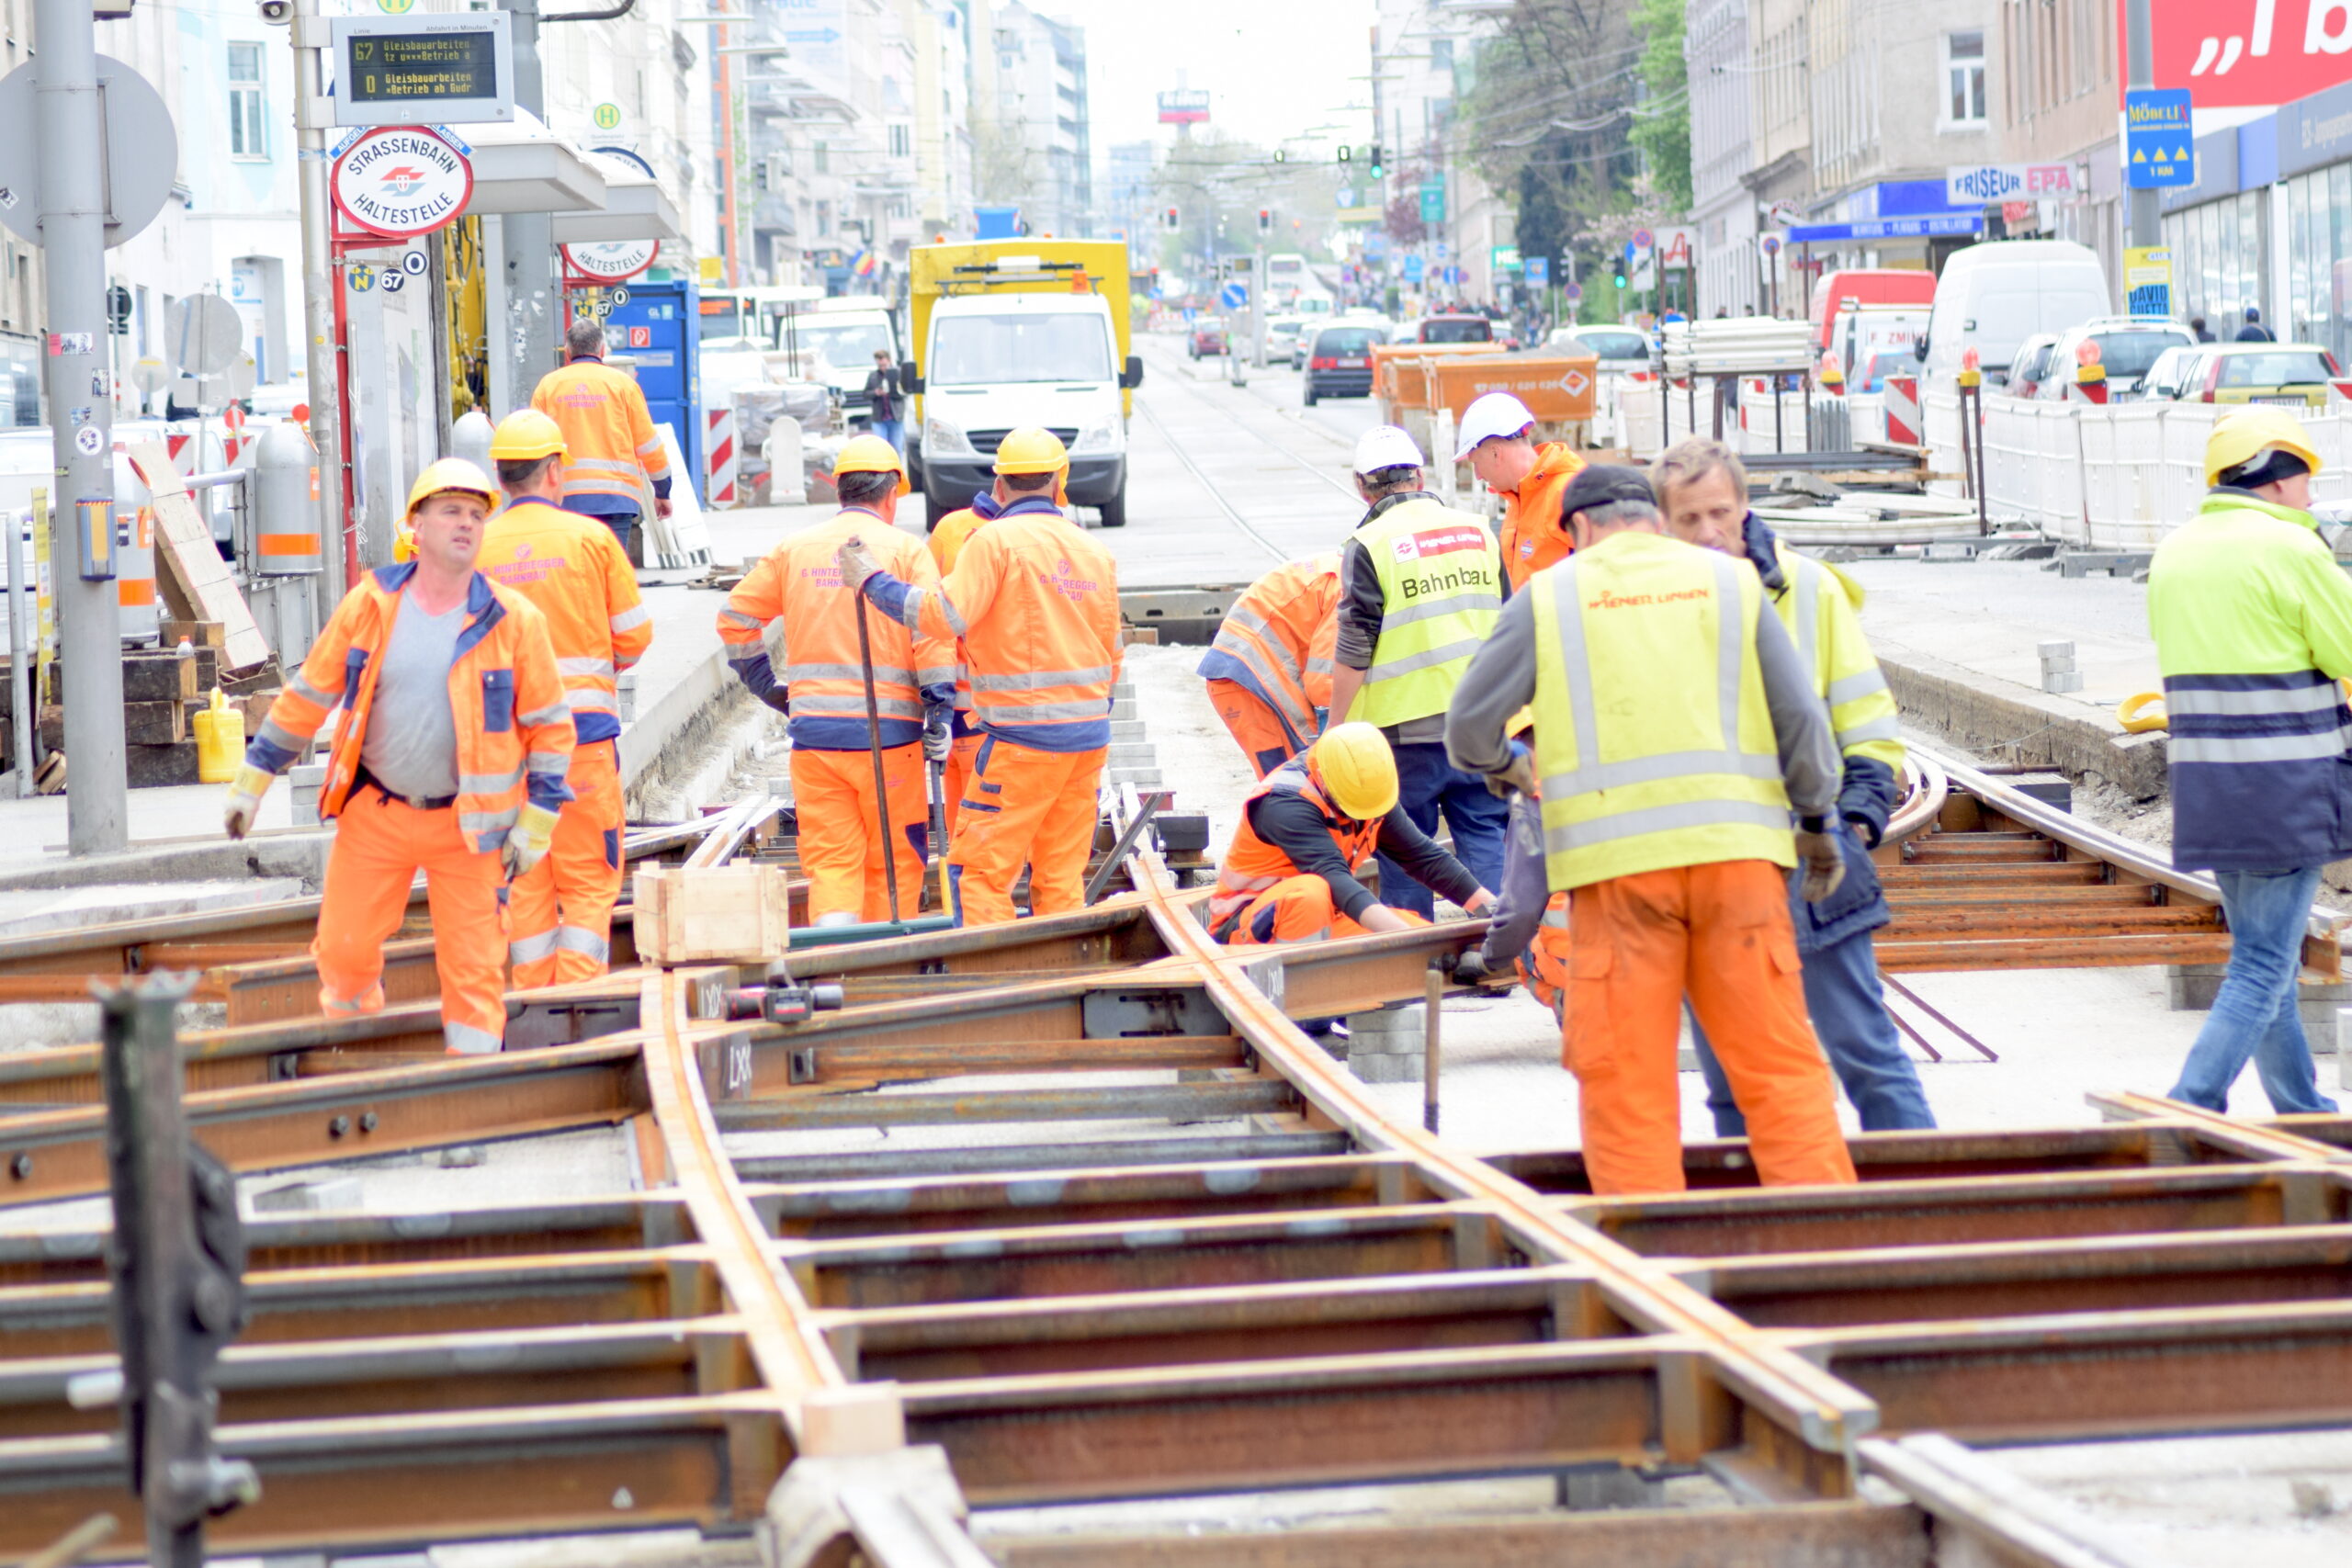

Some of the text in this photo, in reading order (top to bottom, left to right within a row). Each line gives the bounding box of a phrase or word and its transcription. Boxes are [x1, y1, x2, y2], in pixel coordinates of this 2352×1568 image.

[355, 42, 374, 61] 67
[383, 39, 470, 51] Gleisbauarbeiten
[385, 73, 471, 84] Gleisbauarbeiten
[434, 84, 445, 93] ab
[450, 83, 471, 93] Gudr
[348, 138, 458, 175] STRASSENBAHN
[1954, 165, 2072, 198] FRISEUR EPA
[354, 191, 454, 224] HALTESTELLE
[577, 249, 646, 272] HALTESTELLE
[355, 275, 368, 290] N
[380, 272, 403, 289] 67
[2129, 285, 2168, 303] DAVID
[595, 303, 610, 315] 67
[1401, 567, 1492, 599] Bahnbau
